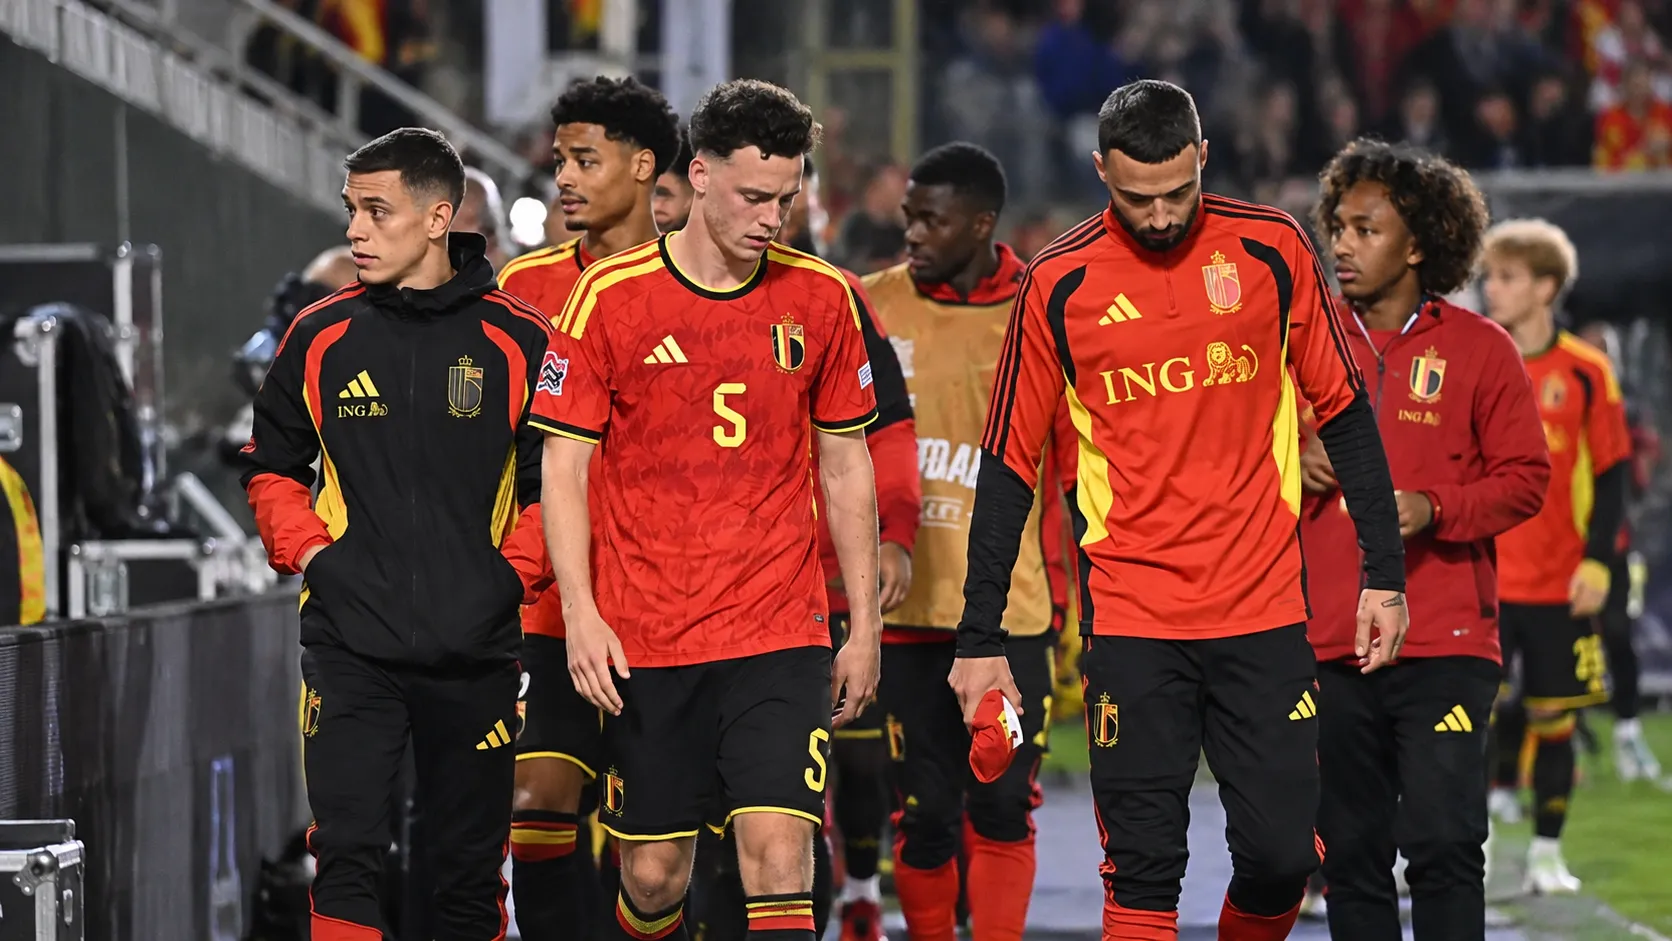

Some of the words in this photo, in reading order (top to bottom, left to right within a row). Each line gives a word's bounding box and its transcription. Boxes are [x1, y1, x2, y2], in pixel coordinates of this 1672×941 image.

[1099, 356, 1195, 405] ING
[337, 405, 366, 418] ING
[713, 382, 747, 448] 5
[1398, 409, 1422, 422] ING
[804, 727, 830, 793] 5
